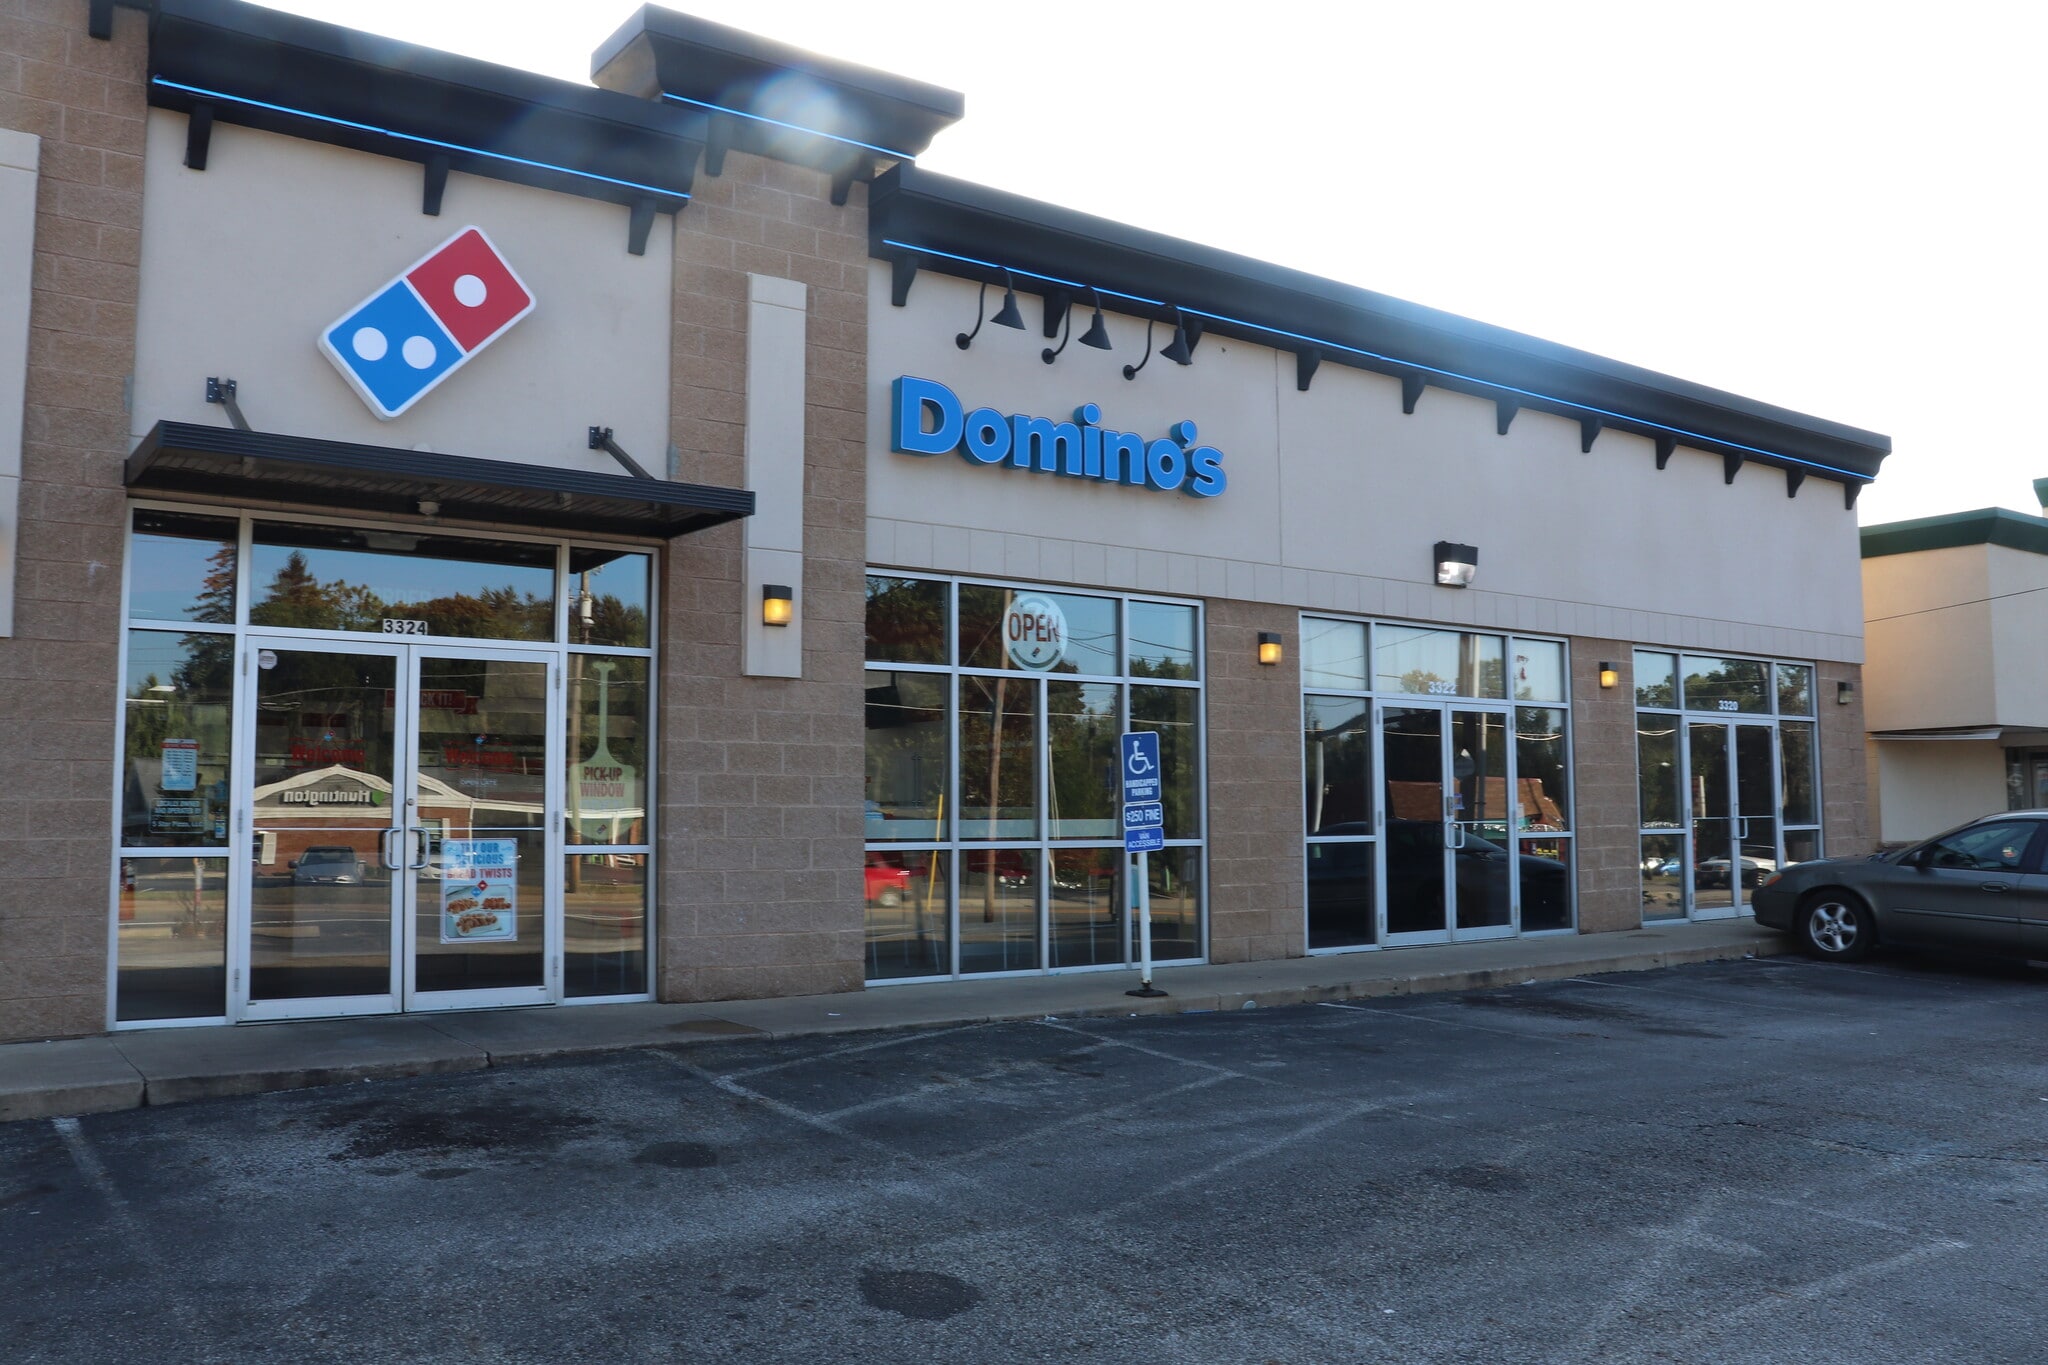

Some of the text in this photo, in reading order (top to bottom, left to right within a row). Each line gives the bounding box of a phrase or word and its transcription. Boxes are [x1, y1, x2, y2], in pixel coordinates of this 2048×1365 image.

[892, 375, 1227, 498] Domino's
[384, 619, 427, 635] 3324
[1008, 612, 1060, 642] OPEN
[1428, 681, 1456, 694] 3322
[1718, 700, 1738, 711] 3320
[583, 766, 622, 782] PICK-UP
[1125, 778, 1158, 789] HANDICAPPED
[580, 783, 625, 797] WINDOW
[1131, 787, 1153, 797] PARKING
[1126, 808, 1161, 822] $250 FINE
[1138, 832, 1150, 840] VAN
[481, 842, 500, 853] OUR
[1128, 838, 1161, 849] ACCESSIBLE
[480, 867, 513, 878] TWISTS
